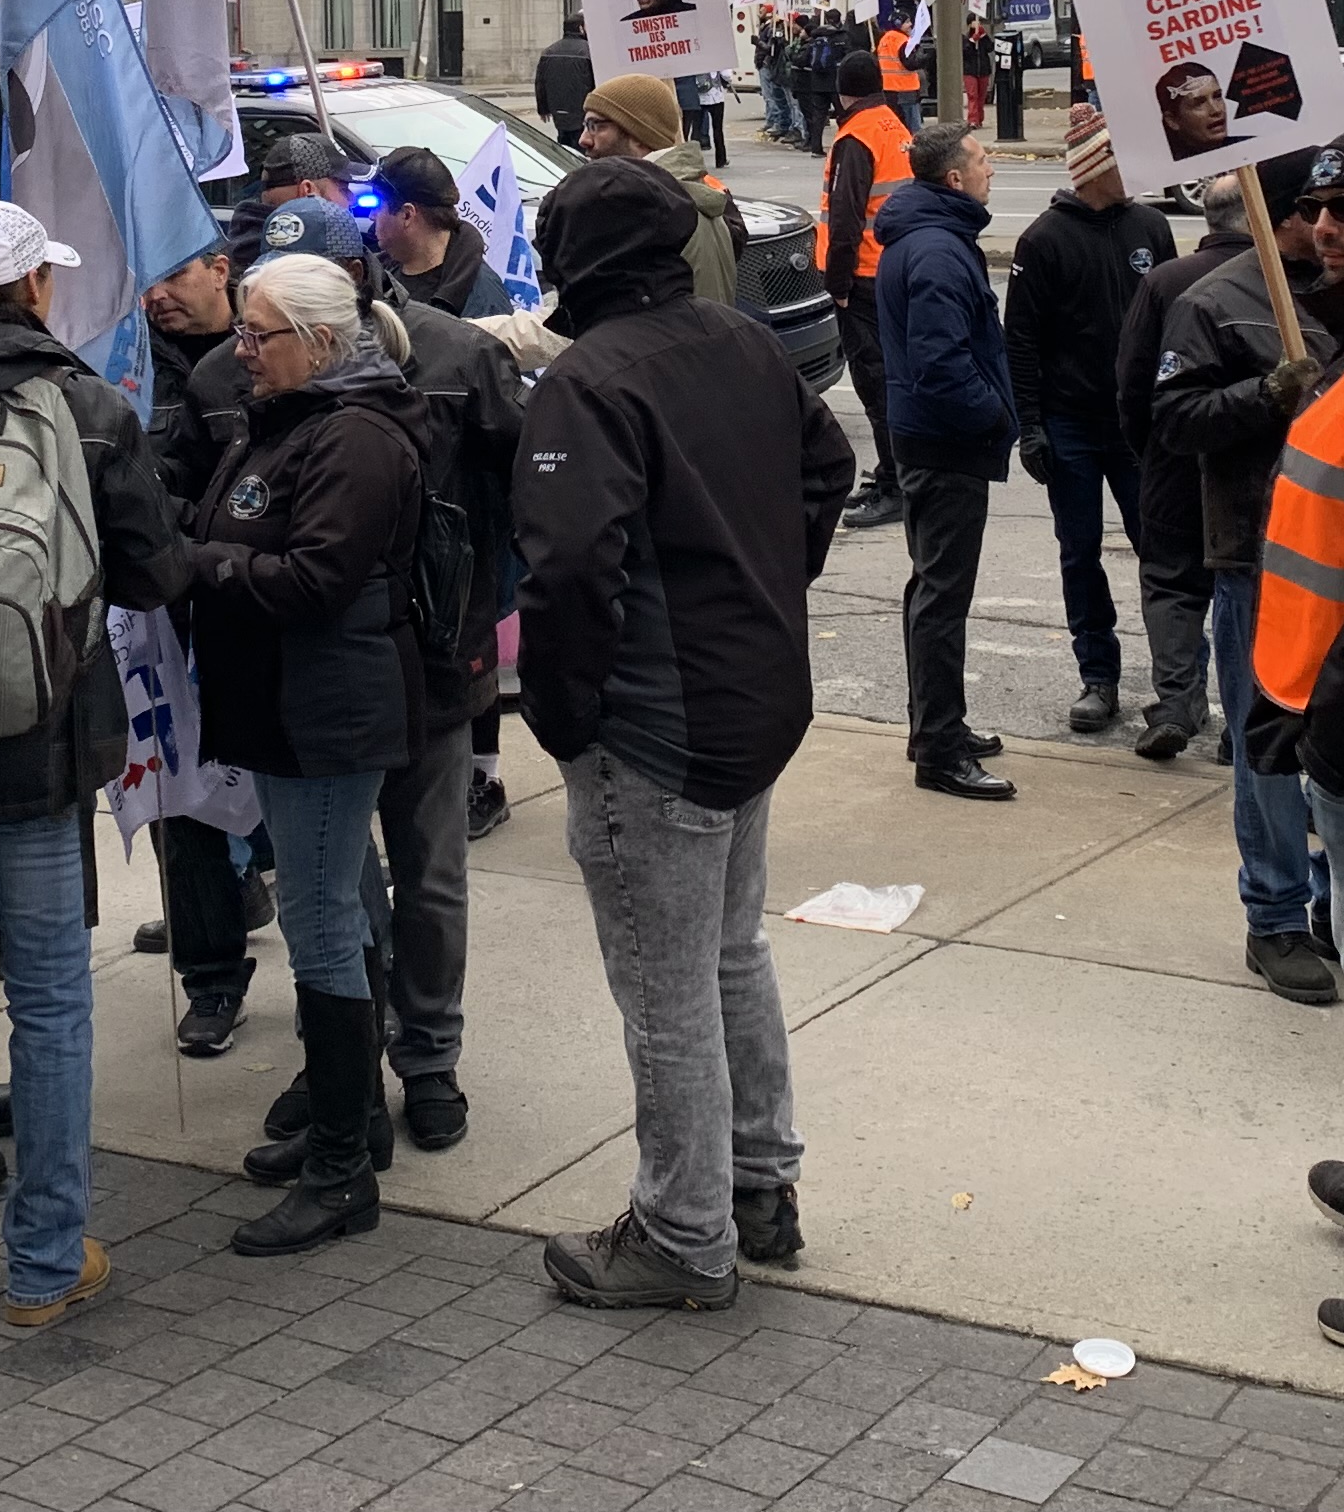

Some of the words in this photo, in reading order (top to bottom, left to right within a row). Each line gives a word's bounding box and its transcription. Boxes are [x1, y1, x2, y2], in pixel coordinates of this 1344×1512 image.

[632, 14, 680, 35] SINISTRE
[649, 30, 667, 44] DES
[1159, 36, 1197, 64] EN
[1198, 18, 1252, 52] BUS
[627, 39, 691, 63] TRANSPORT
